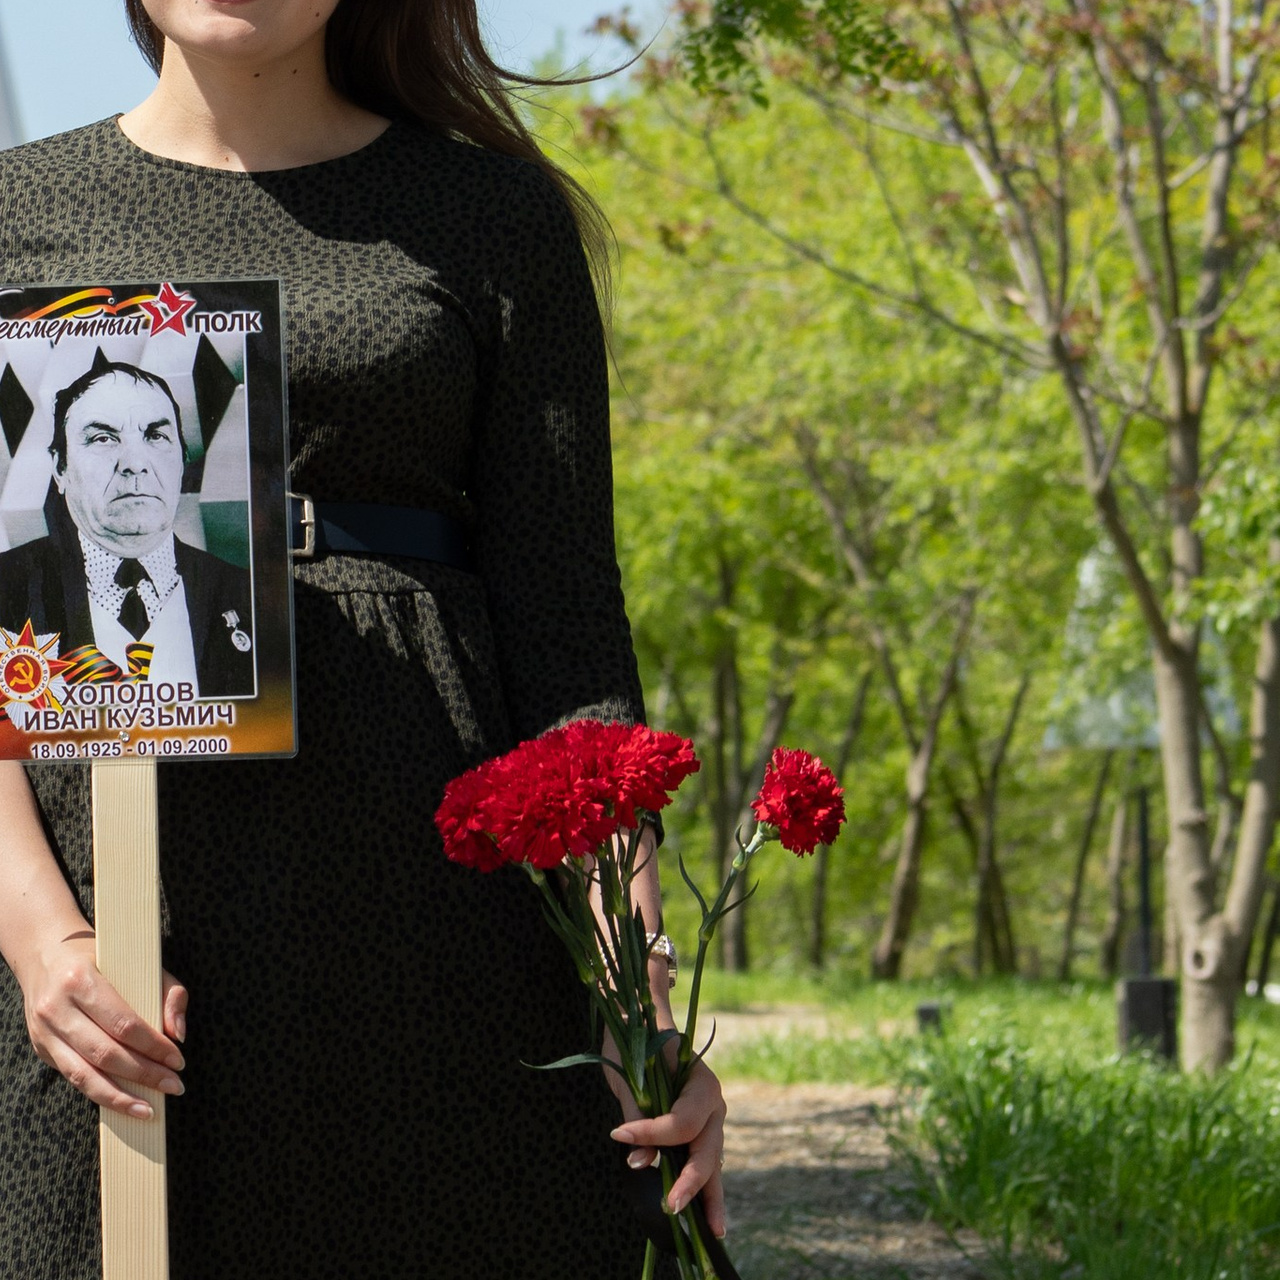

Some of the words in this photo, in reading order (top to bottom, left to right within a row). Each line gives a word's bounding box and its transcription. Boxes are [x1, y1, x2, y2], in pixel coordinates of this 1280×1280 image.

[61, 682, 194, 707] ХОЛОДОВ
[24, 709, 97, 731] ИВАН
[108, 704, 233, 729] КУЗЬМИЧ
[31, 742, 121, 759] 18.09.1925
[137, 738, 228, 756] 01.09.2000
